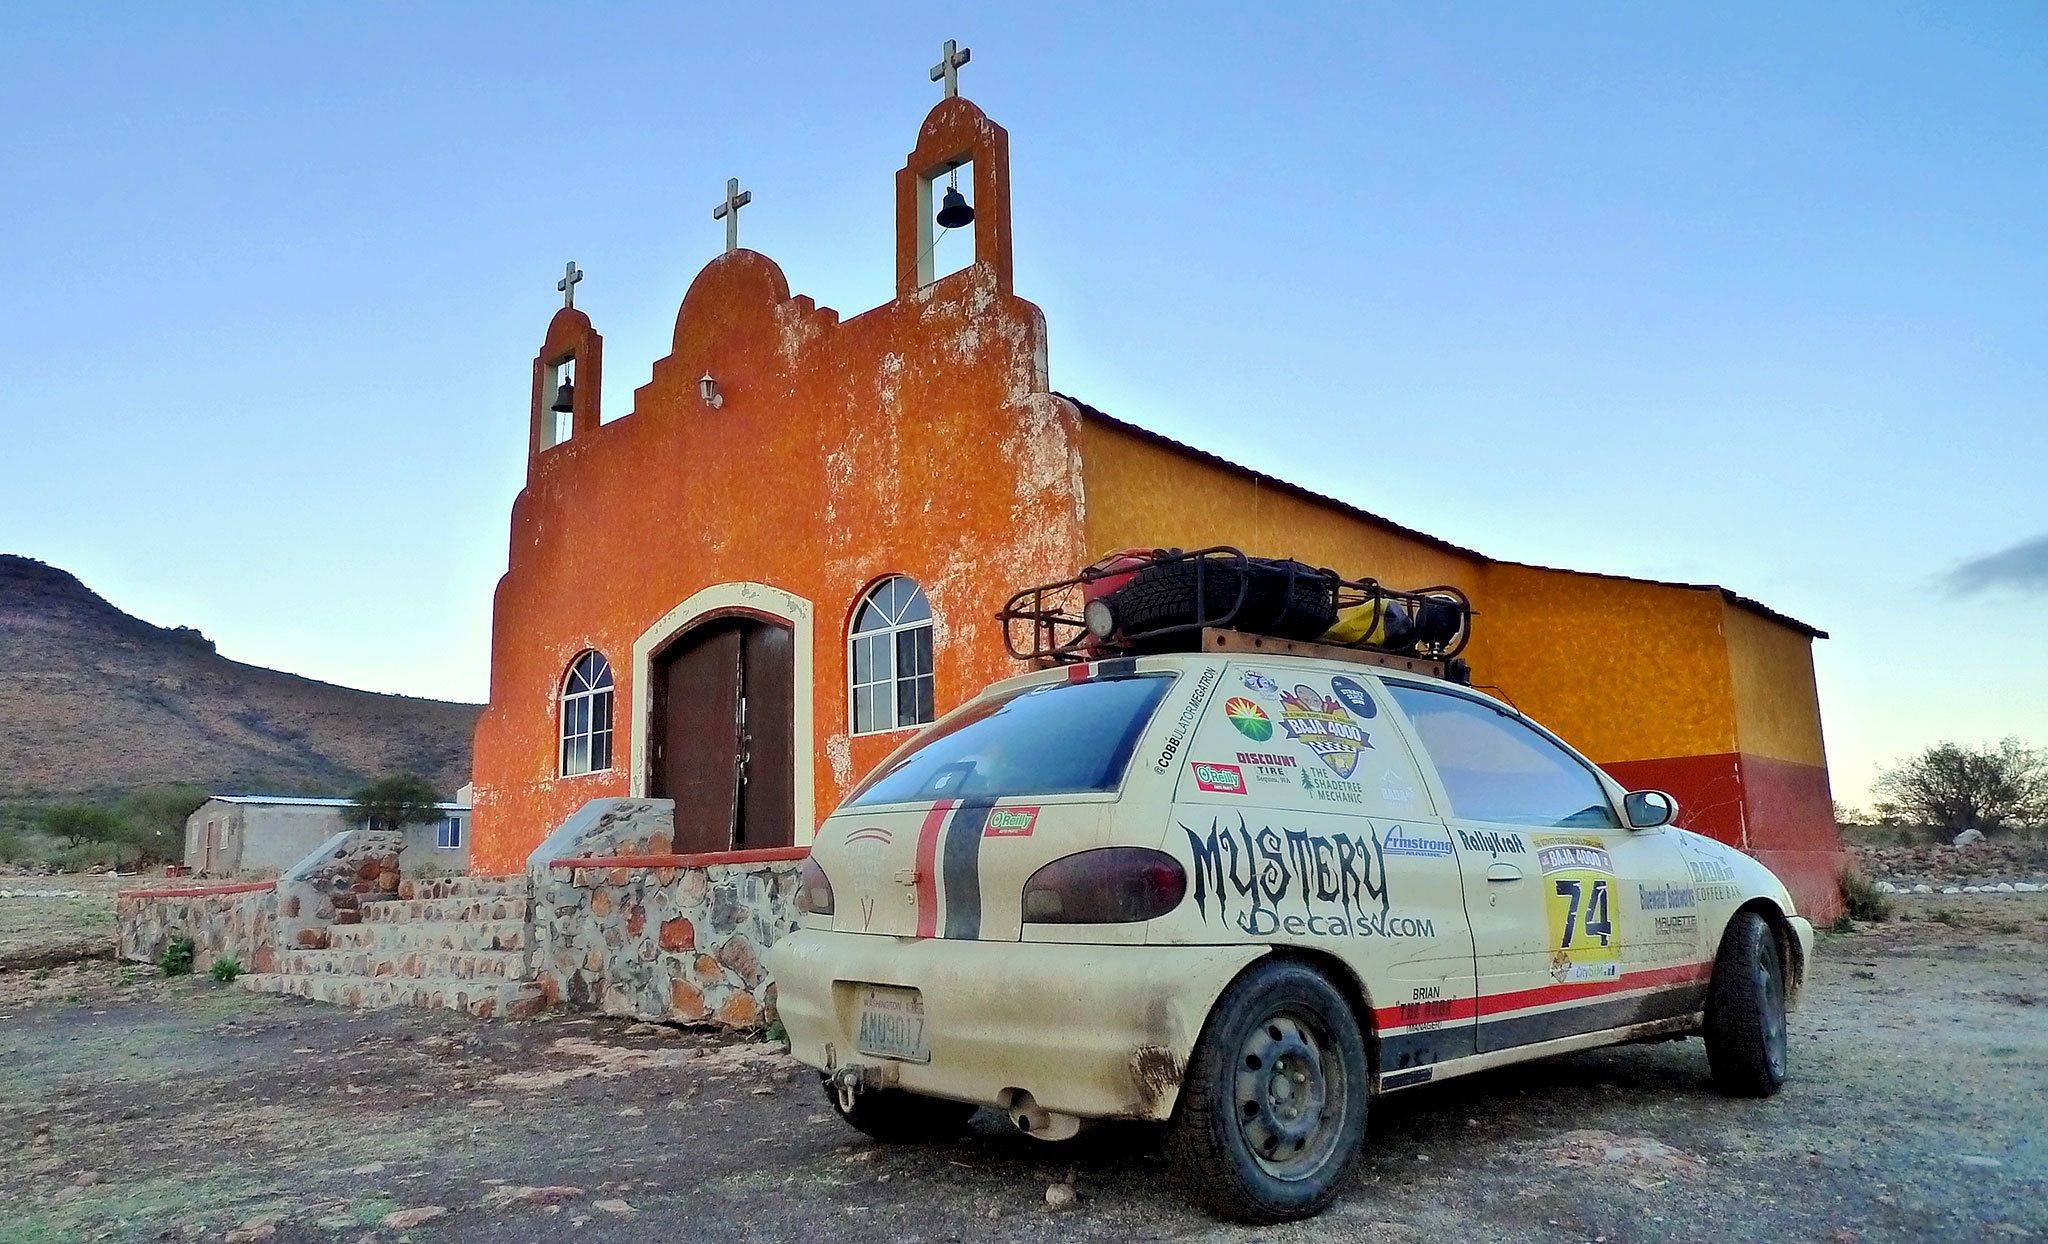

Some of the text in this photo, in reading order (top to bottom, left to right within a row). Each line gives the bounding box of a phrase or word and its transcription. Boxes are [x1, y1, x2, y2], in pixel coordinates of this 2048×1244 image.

[1288, 720, 1362, 741] BAJA 4000
[1236, 752, 1297, 767] DISCOUNT
[1197, 766, 1239, 788] O'Reilly
[1257, 766, 1284, 775] TIRE
[1310, 767, 1328, 779] THE
[1314, 778, 1362, 793] SHADETREE
[1317, 790, 1362, 804] MECHANIC
[991, 811, 1033, 829] O'Reilly
[1457, 829, 1526, 859] RallyKraft
[1548, 848, 1601, 867] BAJA 4000
[1178, 809, 1390, 934] MYSTERY
[1696, 885, 1744, 901] COFFEE BAR
[1555, 880, 1613, 948] 74
[1413, 986, 1440, 1000] BRIAN
